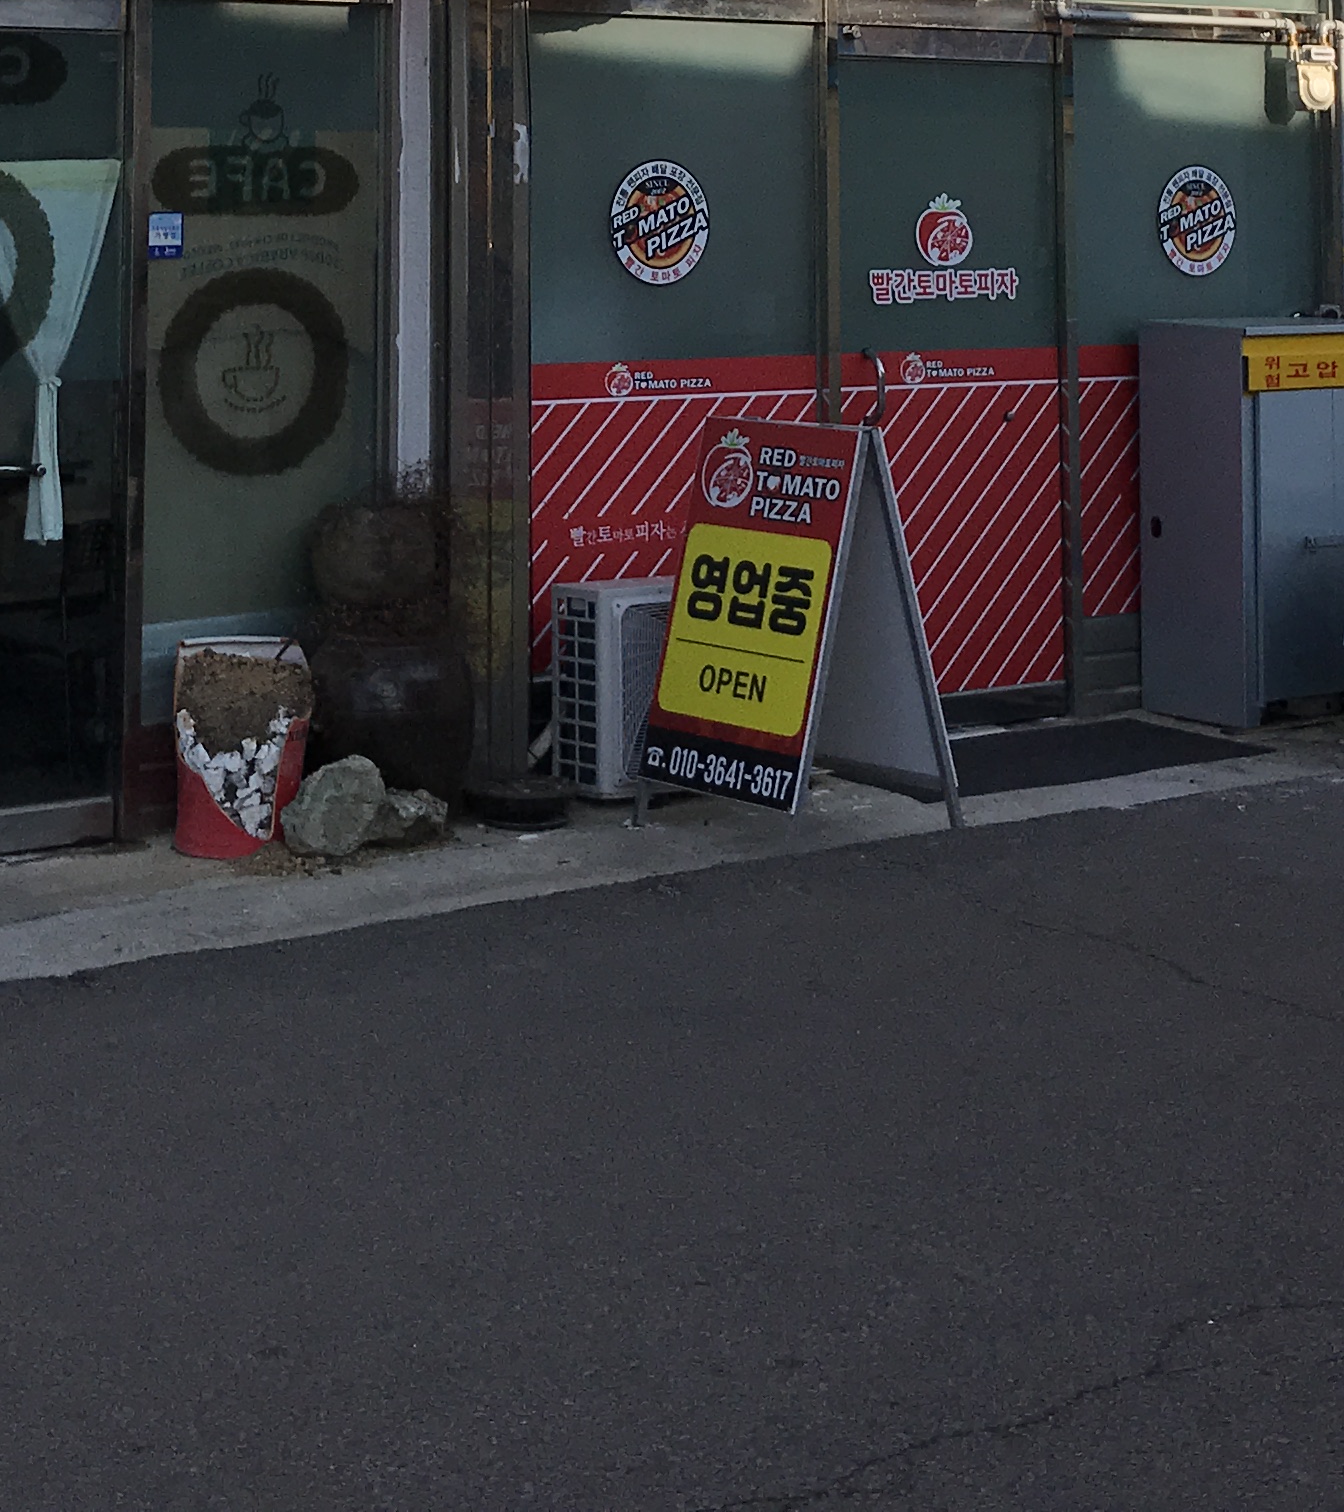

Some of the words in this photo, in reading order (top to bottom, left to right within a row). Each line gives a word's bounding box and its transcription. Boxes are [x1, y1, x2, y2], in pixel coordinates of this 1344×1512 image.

[612, 206, 639, 229] RED
[1160, 205, 1181, 224] RED
[647, 211, 708, 258] PIZZA
[1186, 214, 1234, 251] PIZZA
[869, 267, 1019, 304] 빨간토마토피자
[634, 371, 653, 381] RED
[926, 360, 943, 369] RED
[967, 365, 995, 377] PIZZA
[680, 377, 712, 389] PIZZA
[760, 447, 797, 468] RED
[750, 496, 812, 524] PIZZA
[687, 553, 815, 637] 영업중
[699, 664, 768, 703] OPEN
[669, 746, 794, 801] 010-3641-3617
